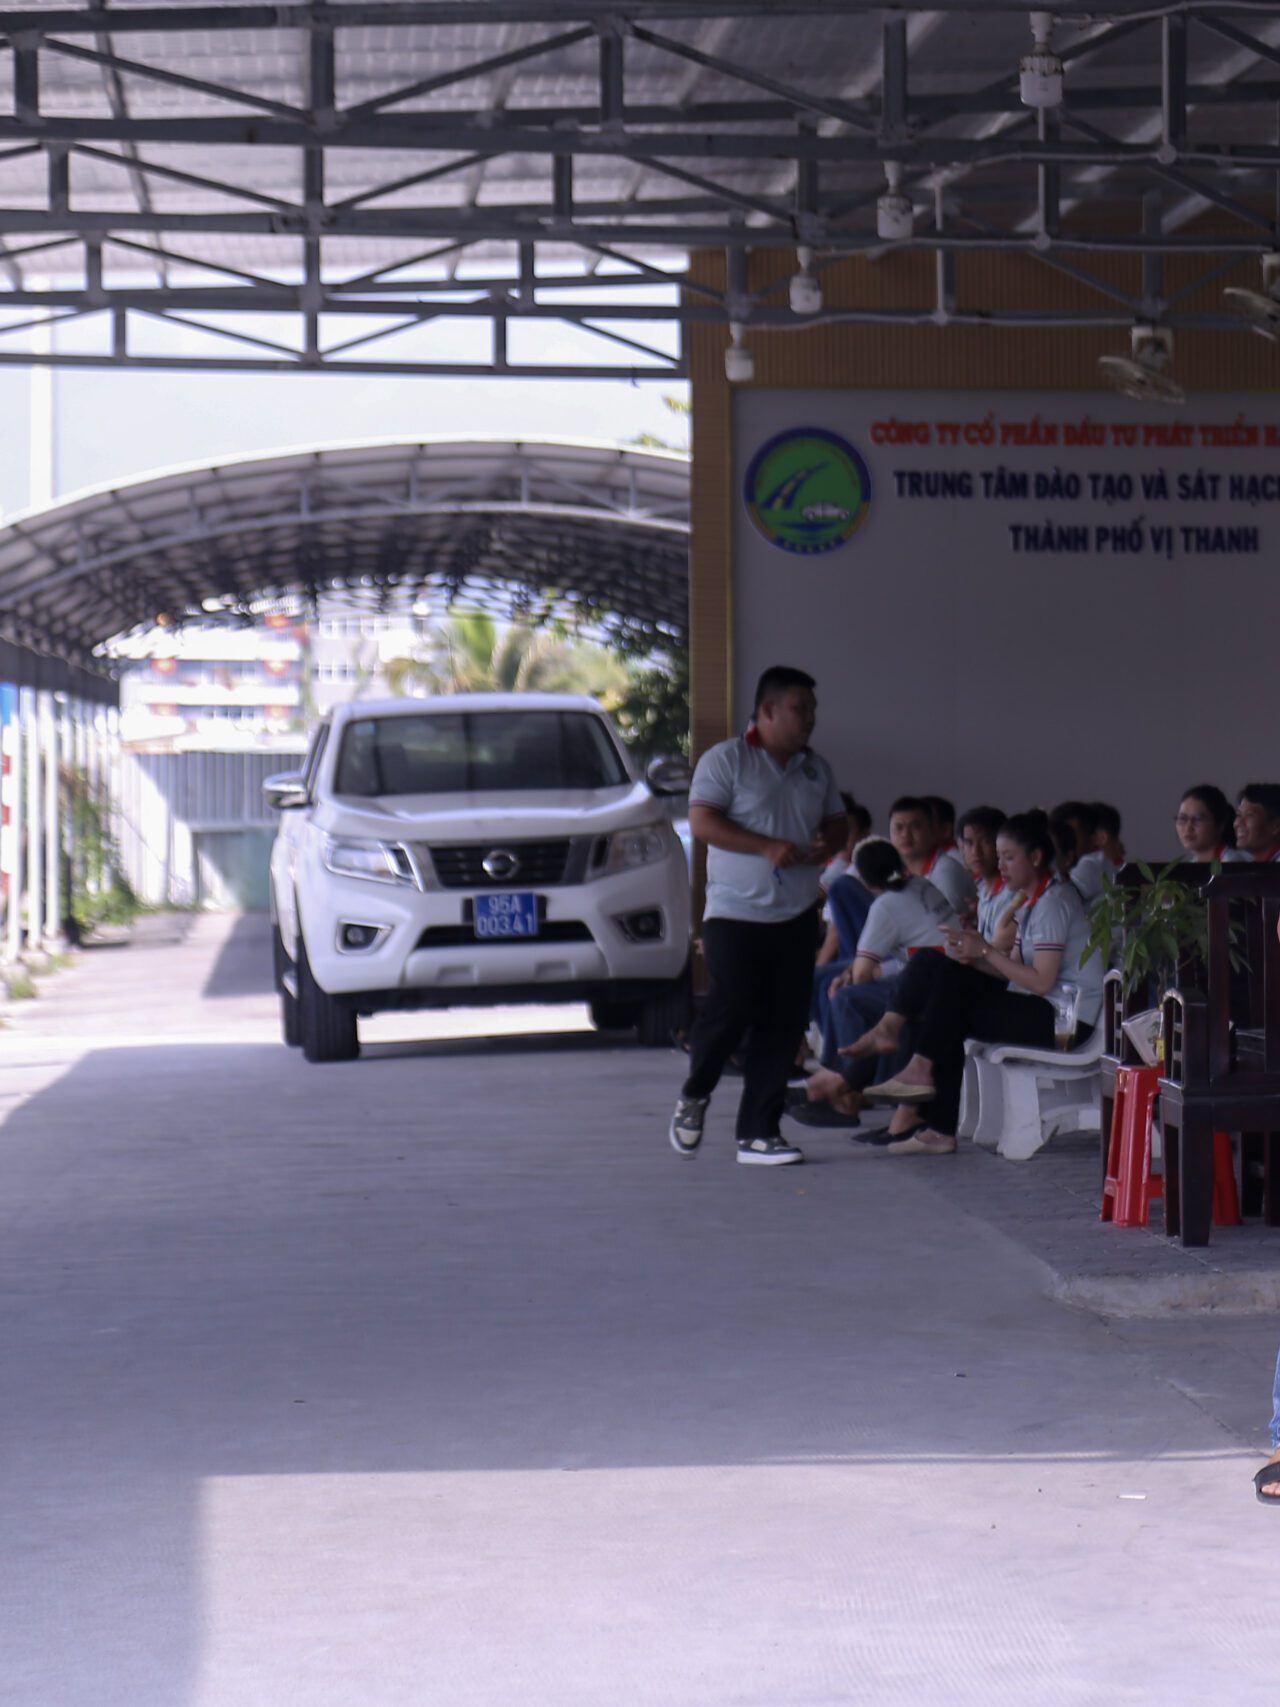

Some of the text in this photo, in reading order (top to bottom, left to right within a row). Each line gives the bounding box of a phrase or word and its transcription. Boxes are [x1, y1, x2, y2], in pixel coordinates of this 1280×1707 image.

[870, 415, 931, 446] CÔNG
[937, 422, 960, 446] TY
[893, 470, 974, 499] TRUNG
[980, 465, 1028, 500] TÂM
[1035, 465, 1081, 500] ĐÀO
[1087, 472, 1133, 506] TẠO
[1140, 466, 1169, 501] VÀ
[1177, 467, 1221, 501] SÁT
[1008, 513, 1260, 561] THÀNH PHỐ VỊ THANH
[488, 894, 522, 915] 95A
